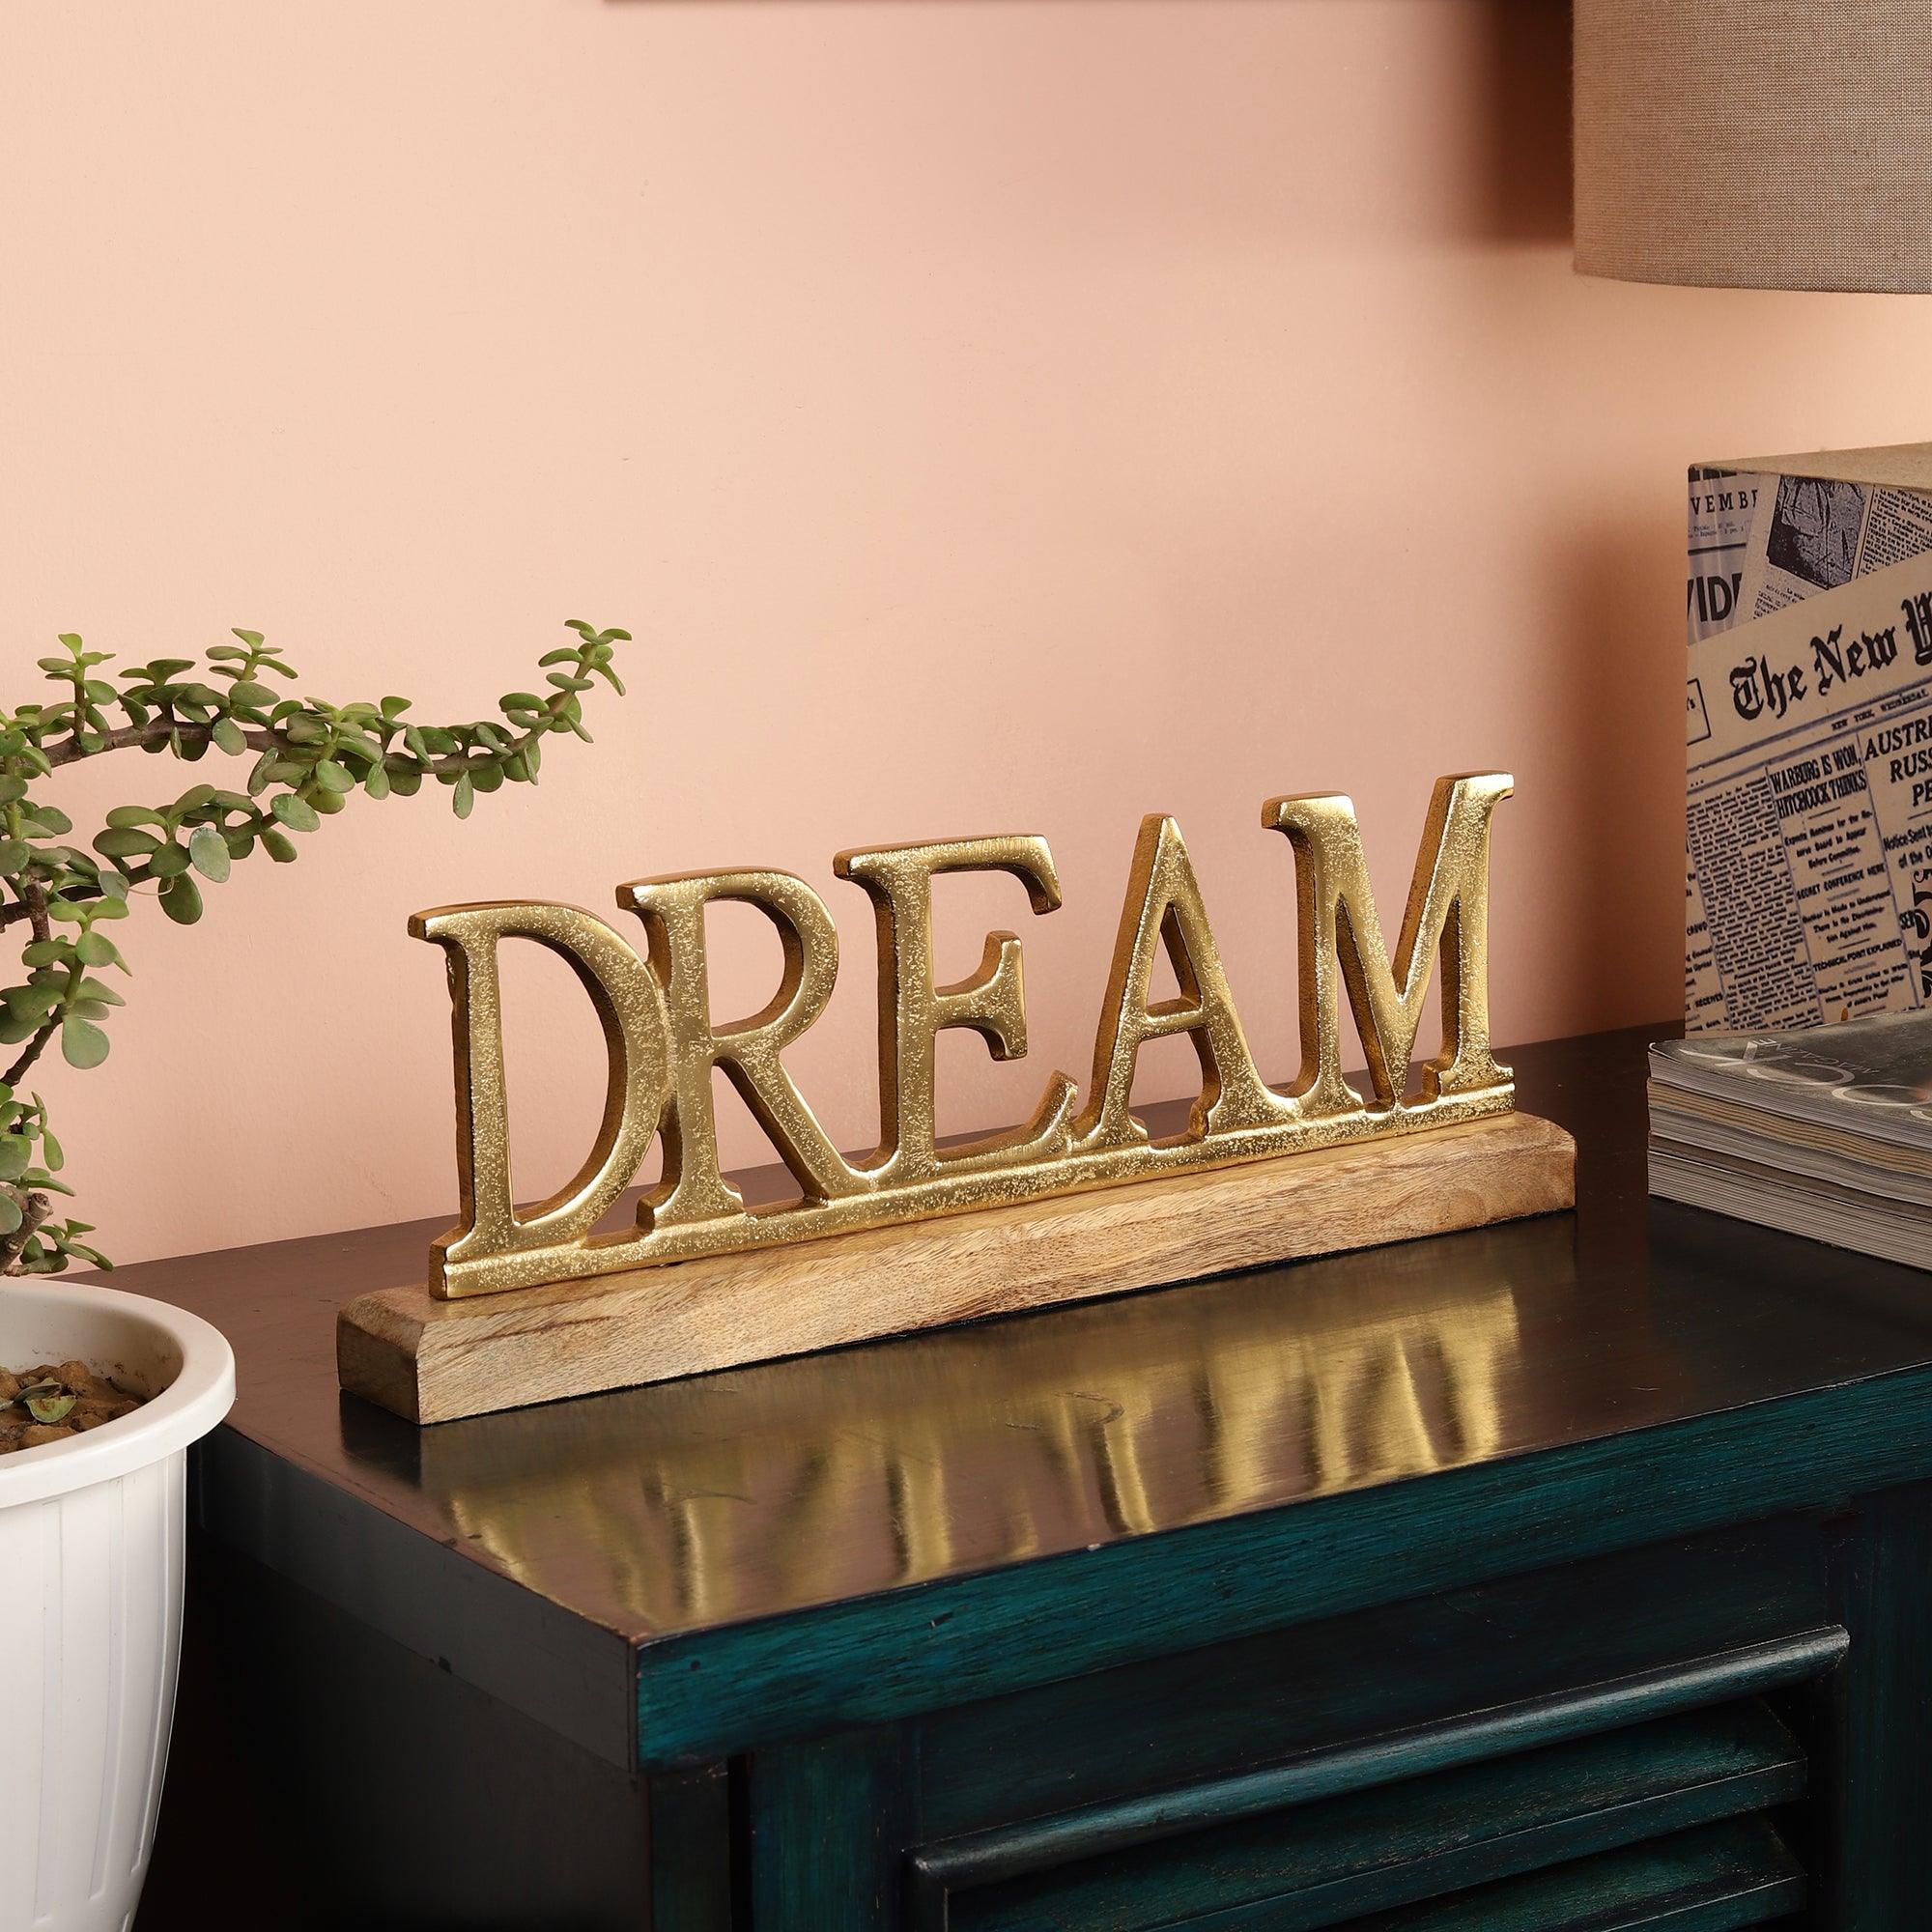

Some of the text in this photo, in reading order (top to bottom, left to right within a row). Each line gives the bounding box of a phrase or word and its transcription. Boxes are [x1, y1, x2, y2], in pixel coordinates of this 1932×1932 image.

[1729, 655, 1807, 721] The
[1810, 624, 1898, 696] New
[1770, 759, 1821, 794] WARBURG
[1821, 754, 1833, 776] IS
[1829, 769, 1866, 800] THINKS
[408, 770, 1515, 1290] DREAM
